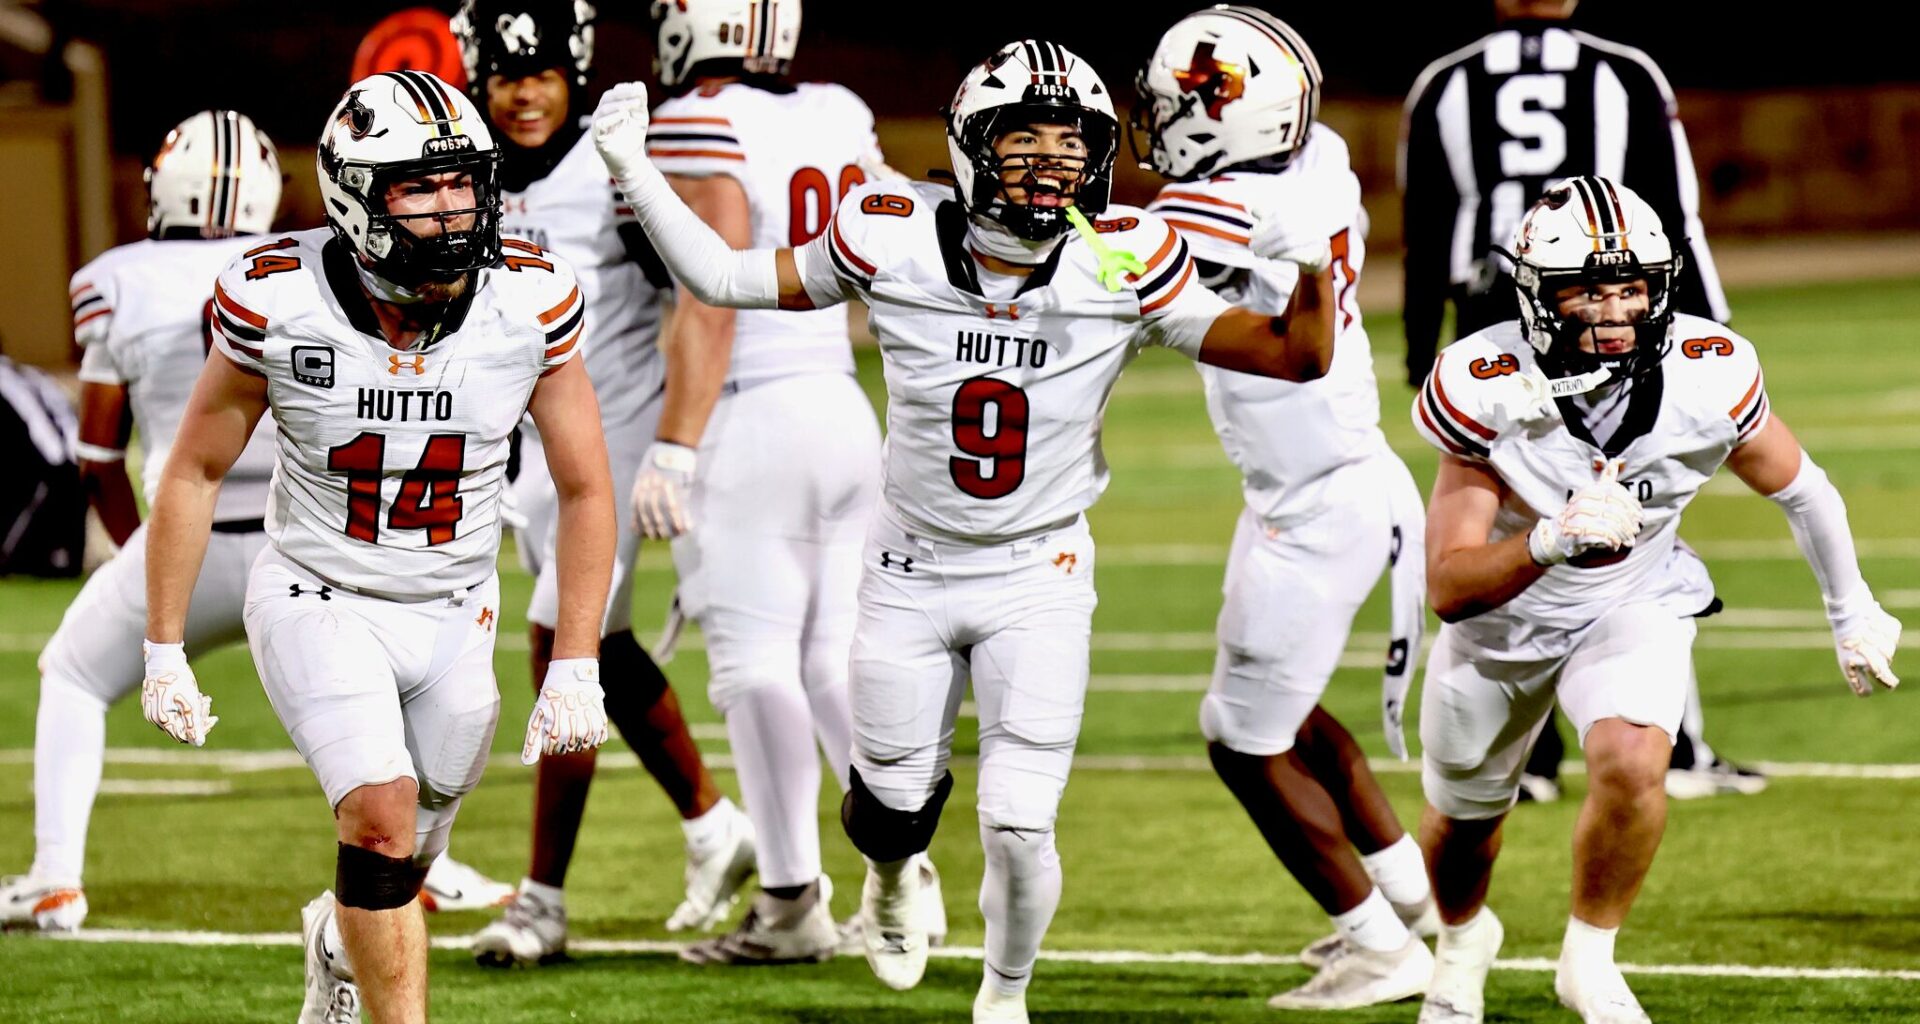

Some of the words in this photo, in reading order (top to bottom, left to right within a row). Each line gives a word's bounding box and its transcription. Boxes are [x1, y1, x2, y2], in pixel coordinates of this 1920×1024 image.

[1034, 84, 1071, 98] 78634
[1280, 122, 1292, 143] 7
[1496, 73, 1567, 177] S
[861, 194, 914, 217] 9
[243, 237, 301, 281] 14
[956, 331, 1047, 368] HUTTO
[1682, 336, 1734, 359] 3
[295, 349, 332, 378] C
[1469, 354, 1520, 380] 3
[357, 388, 453, 421] HUTTO
[949, 376, 1029, 500] 9
[327, 432, 467, 546] 14
